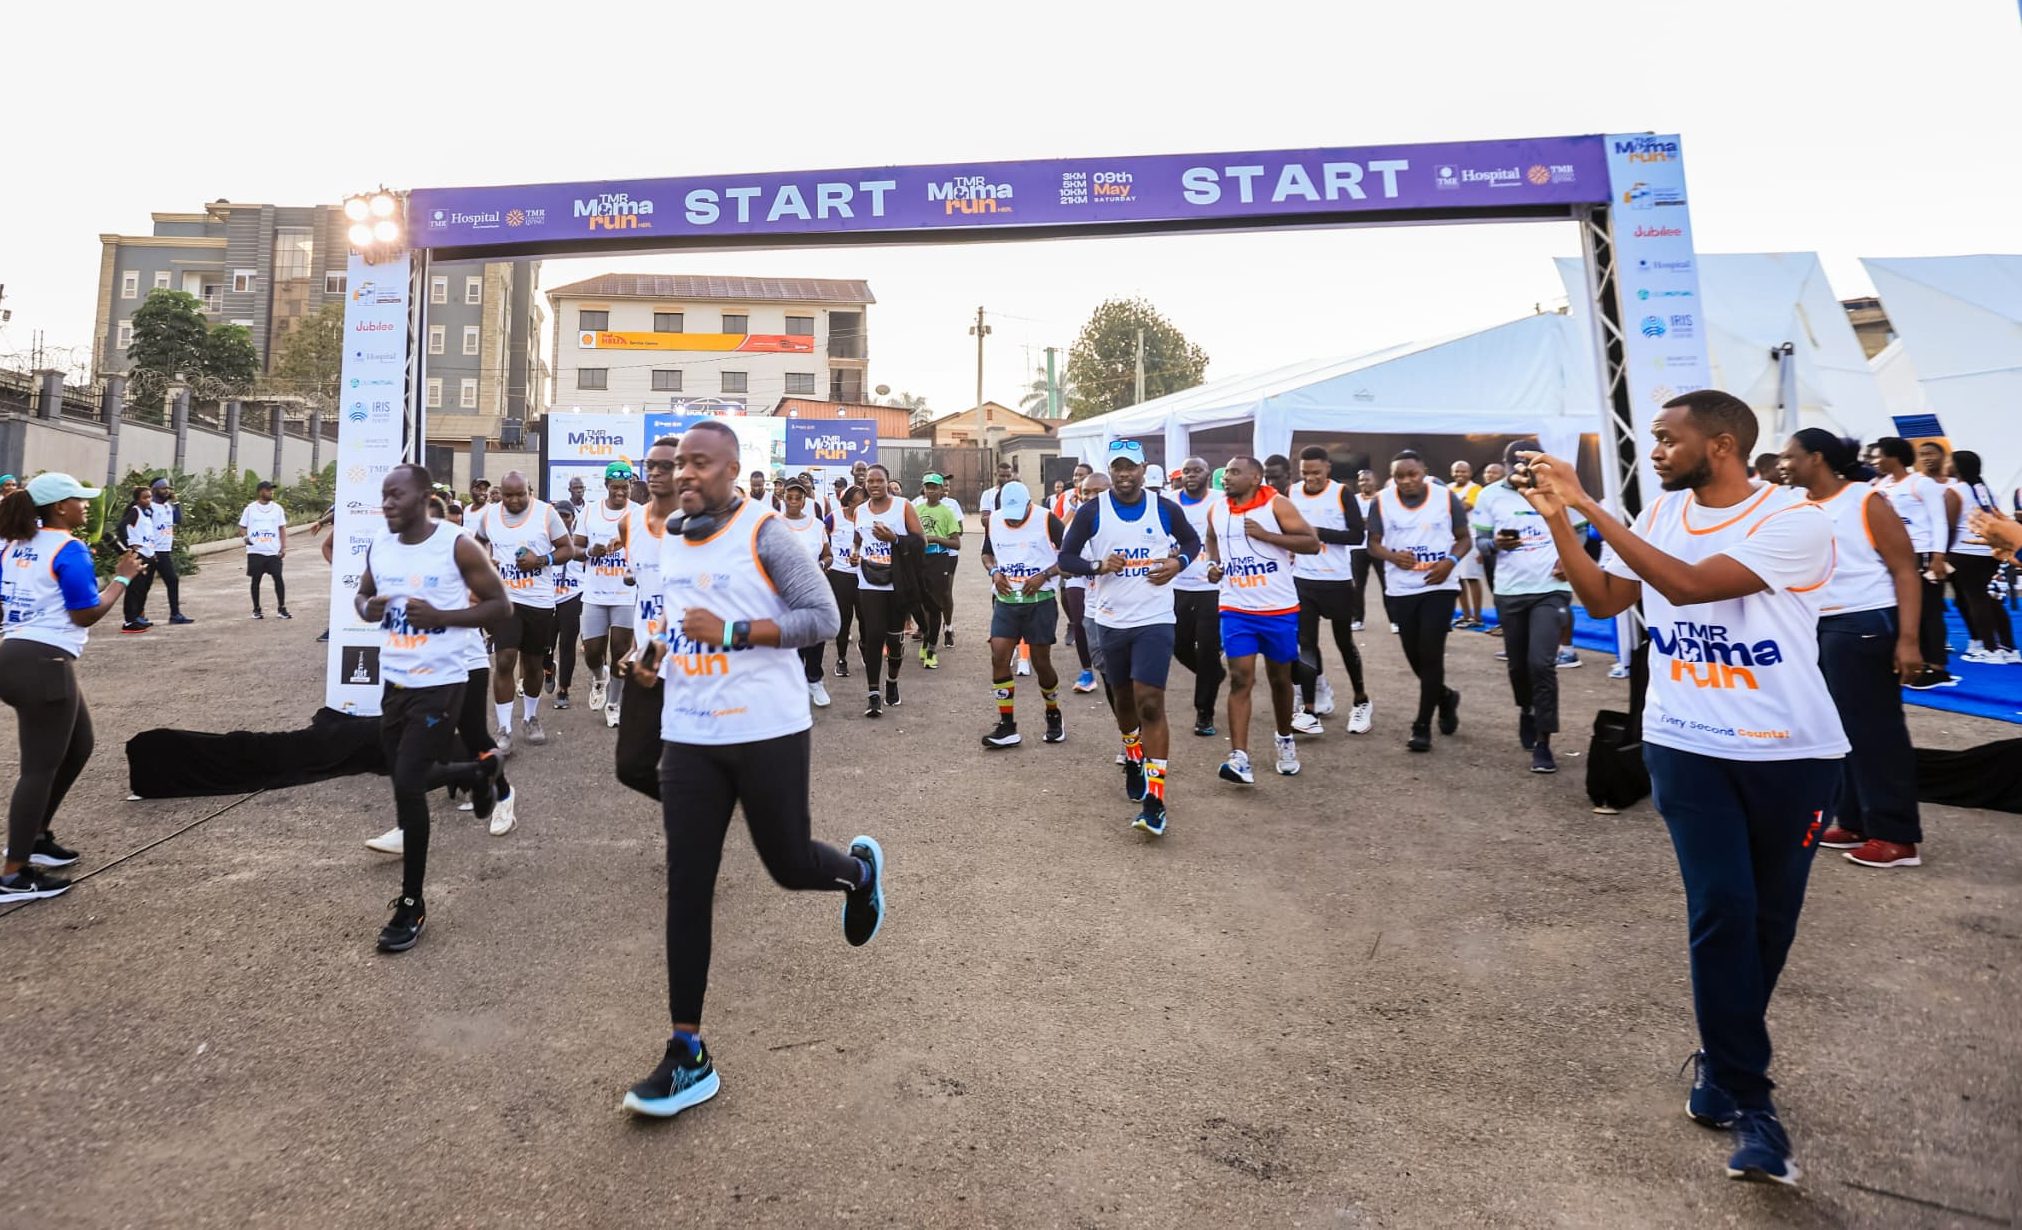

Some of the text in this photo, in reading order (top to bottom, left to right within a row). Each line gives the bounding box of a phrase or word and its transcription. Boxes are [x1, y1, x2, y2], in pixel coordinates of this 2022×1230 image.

[953, 176, 986, 187] TMR
[1062, 172, 1087, 180] 3KM
[1093, 171, 1133, 184] 09th
[1181, 159, 1410, 205] START
[1461, 167, 1520, 185] Hospital
[1062, 180, 1087, 188] 5KM
[1093, 183, 1131, 197] May
[1059, 188, 1088, 196] 10KM
[599, 193, 629, 204] TMR
[685, 179, 897, 225] START
[1060, 196, 1088, 204] 21KM
[945, 198, 997, 215] run
[451, 211, 500, 226] Hospital
[589, 213, 638, 230] run
[1633, 225, 1682, 237] Jubilee
[355, 320, 395, 332] Jubilee
[372, 401, 391, 413] IRIS
[578, 443, 613, 455] run
[815, 448, 847, 459] run
[1114, 548, 1150, 559] TMR
[1231, 556, 1255, 565] TMR
[1229, 574, 1267, 589] run
[1674, 621, 1728, 642] TMR
[1670, 658, 1760, 690] run
[1661, 713, 1687, 728] Every
[1689, 720, 1735, 737] Second
